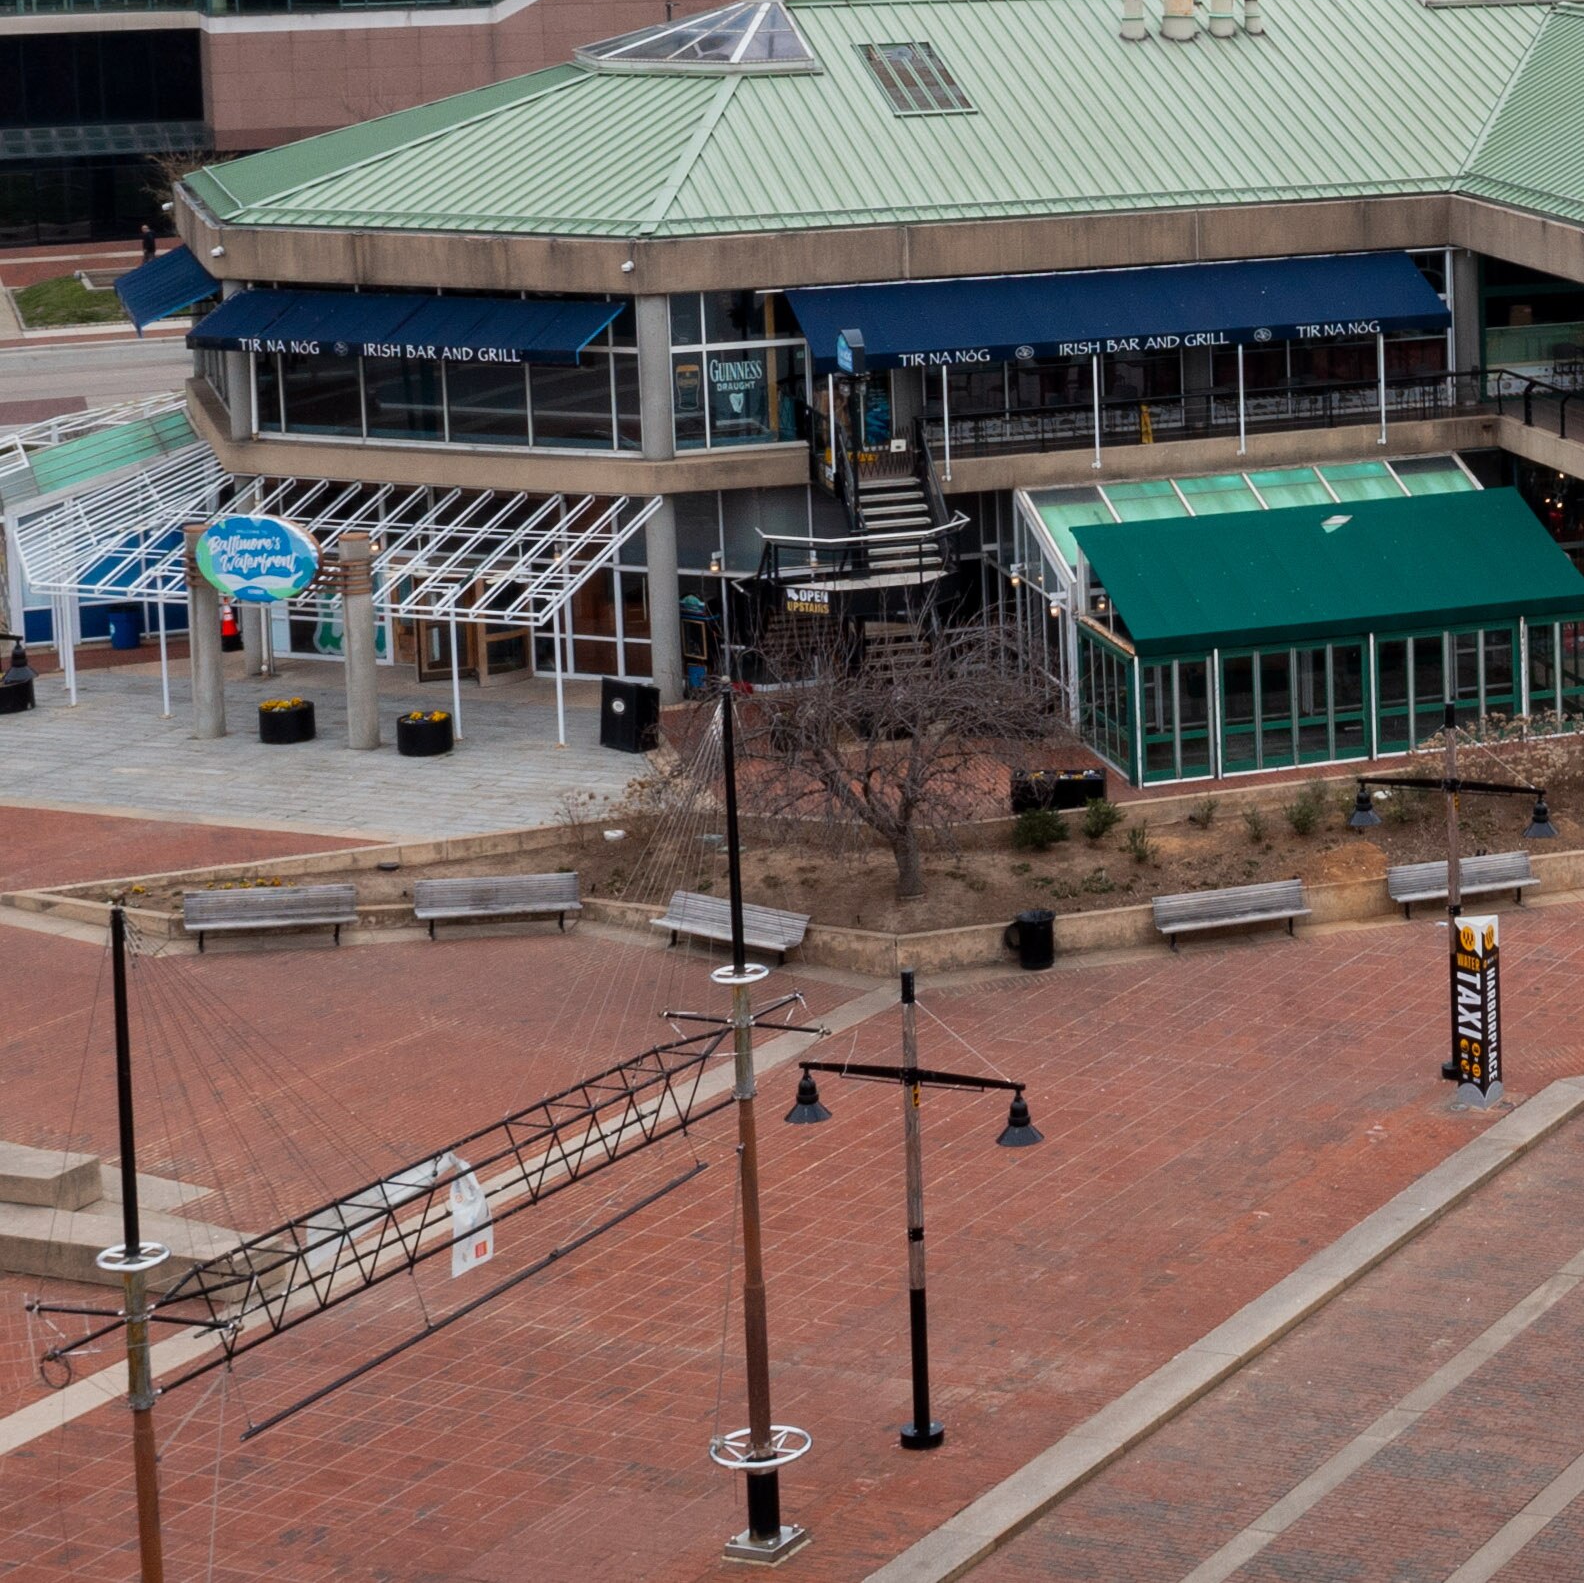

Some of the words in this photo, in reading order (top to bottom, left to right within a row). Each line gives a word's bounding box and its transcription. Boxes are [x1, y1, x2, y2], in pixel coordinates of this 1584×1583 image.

[1296, 325, 1321, 339] TIR
[1324, 323, 1346, 336] NA
[238, 338, 262, 353] TIR
[266, 339, 287, 354] NA
[363, 343, 401, 357] IRISH
[406, 344, 437, 360] BAR
[442, 346, 473, 361] AND
[478, 347, 521, 363] GRILL
[898, 353, 925, 368] TIR
[929, 352, 953, 365] NA
[1059, 341, 1100, 357] IRISH
[1106, 338, 1140, 354] BAR
[1144, 335, 1180, 351] AND
[1184, 332, 1230, 348] GRILL
[709, 359, 763, 383] GUINNESS
[716, 380, 756, 391] DRAUGHT
[220, 551, 297, 574] Waterfront
[786, 601, 830, 614] UPSTAIRS
[799, 589, 829, 603] OPEN
[1457, 953, 1480, 971] WATER
[1457, 972, 1482, 1040] TAXI
[1486, 967, 1498, 1083] HARBORPLACE
